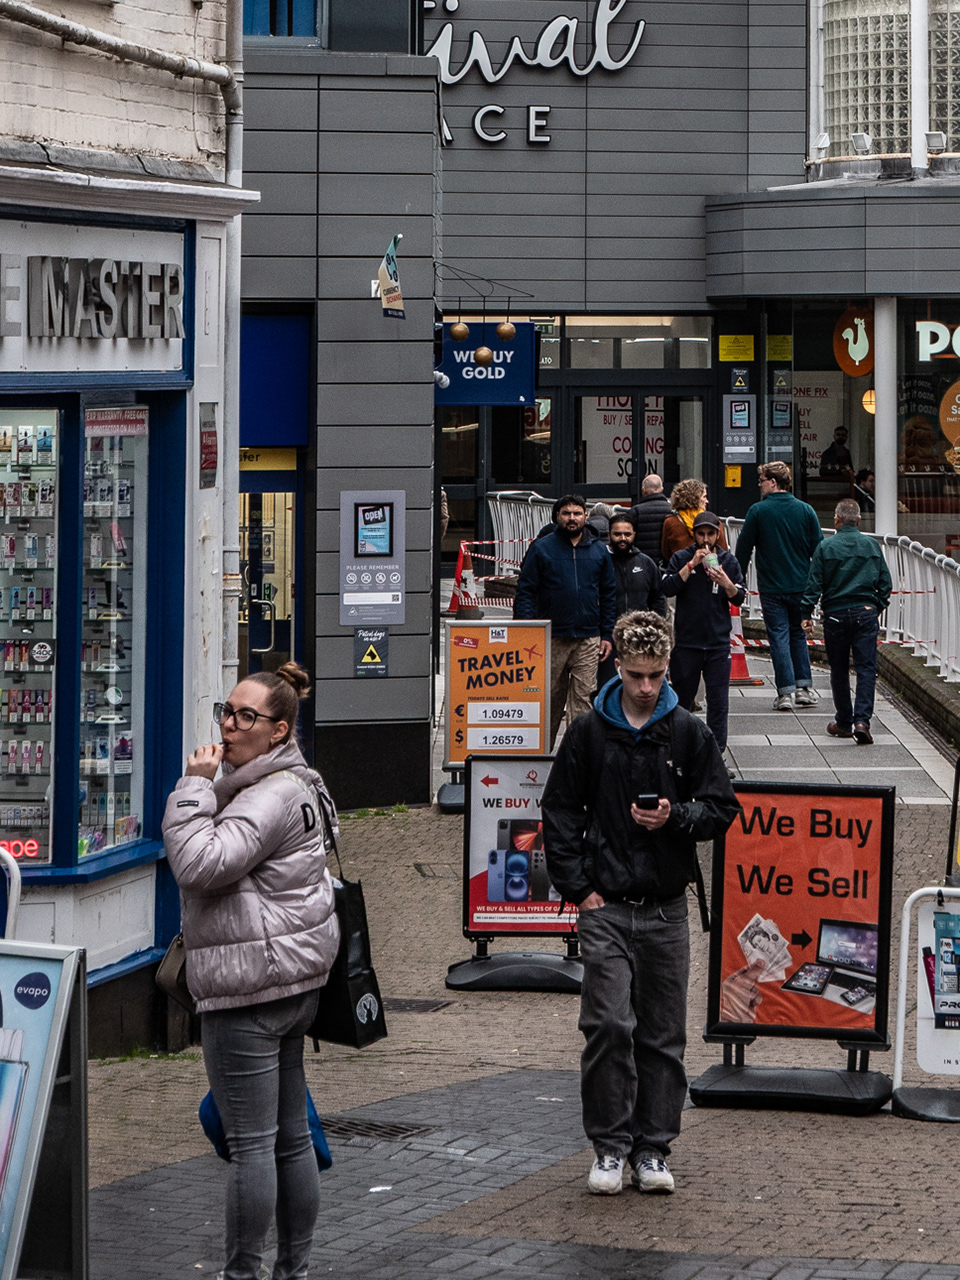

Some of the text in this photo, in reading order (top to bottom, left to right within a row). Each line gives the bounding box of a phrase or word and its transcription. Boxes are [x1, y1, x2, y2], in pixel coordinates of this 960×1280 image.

[28, 256, 185, 339] MASTER
[491, 351, 514, 363] UY
[462, 367, 505, 379] GOLD
[815, 387, 828, 396] FIX
[799, 408, 811, 416] UY
[603, 415, 616, 425] BUY
[647, 415, 664, 425] REPA
[799, 421, 811, 429] ELL
[612, 436, 664, 454] CONG
[458, 650, 524, 672] TRAVEL
[466, 666, 536, 690] MONEY
[483, 709, 524, 719] 1.09479
[455, 729, 524, 745] $ 1.26579
[482, 798, 503, 808] WE
[505, 798, 530, 808] BUY
[739, 806, 872, 848] We Buy
[737, 864, 868, 899] We Sell
[17, 986, 48, 997] evapo
